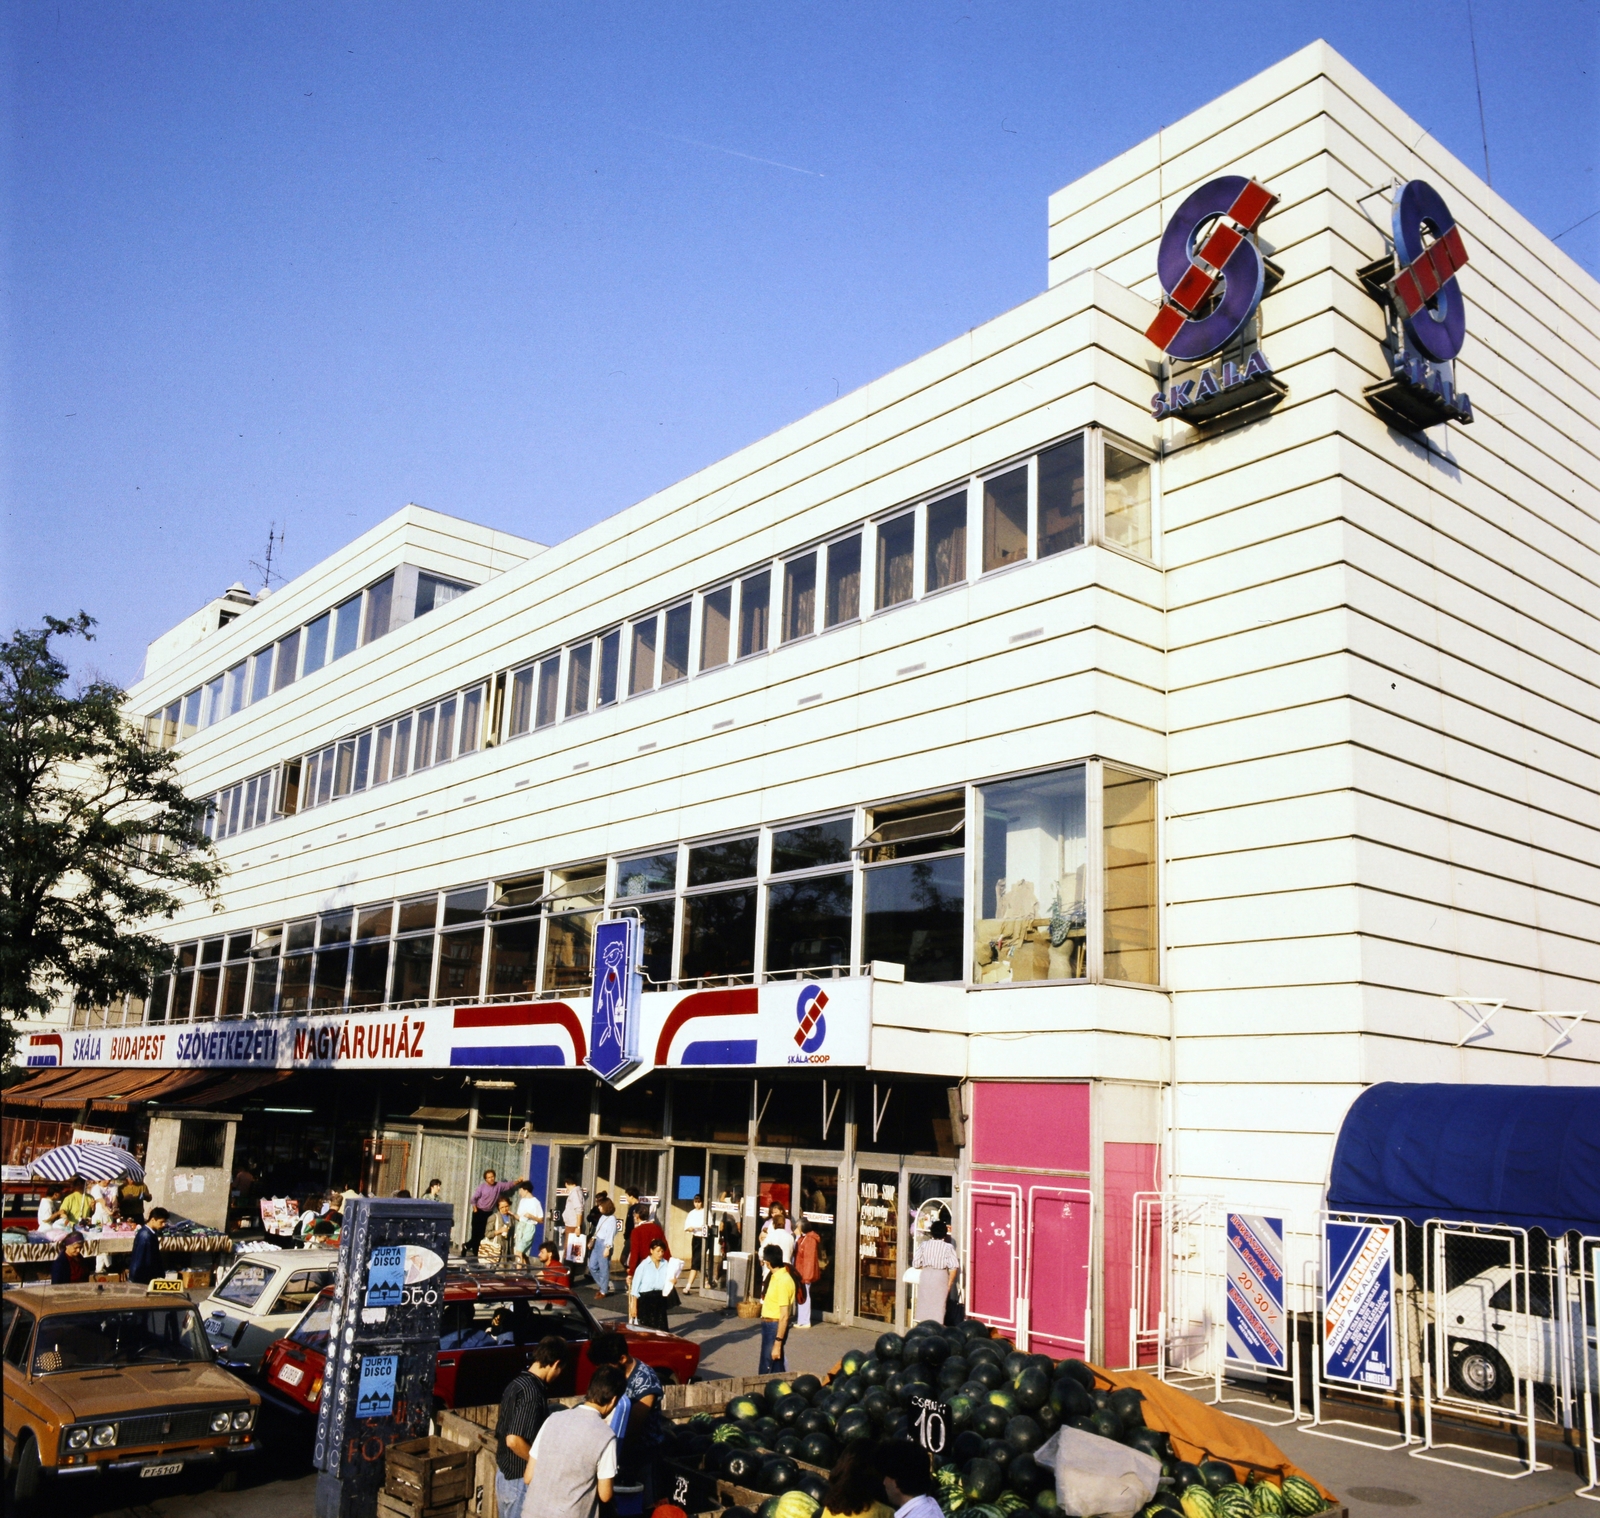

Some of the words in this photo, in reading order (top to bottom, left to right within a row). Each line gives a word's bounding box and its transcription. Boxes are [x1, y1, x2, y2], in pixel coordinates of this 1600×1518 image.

[73, 1034, 101, 1061] SKÁLA
[110, 1034, 166, 1060] BUDAPEST
[176, 1027, 278, 1060] SZÖVETKEZETI
[294, 1015, 425, 1060] NAGYÁRUHÁZ
[373, 1256, 401, 1267] DISCO
[375, 1248, 401, 1257] JURTA
[1242, 1248, 1266, 1280] BOTOK
[155, 1282, 180, 1290] TAXI
[1324, 1227, 1388, 1325] NECKERMANN
[1328, 1319, 1347, 1347] SHOP
[1346, 1307, 1353, 1317] A
[364, 1366, 392, 1377] DISCO
[365, 1357, 393, 1367] JURTA
[914, 1407, 946, 1453] 10
